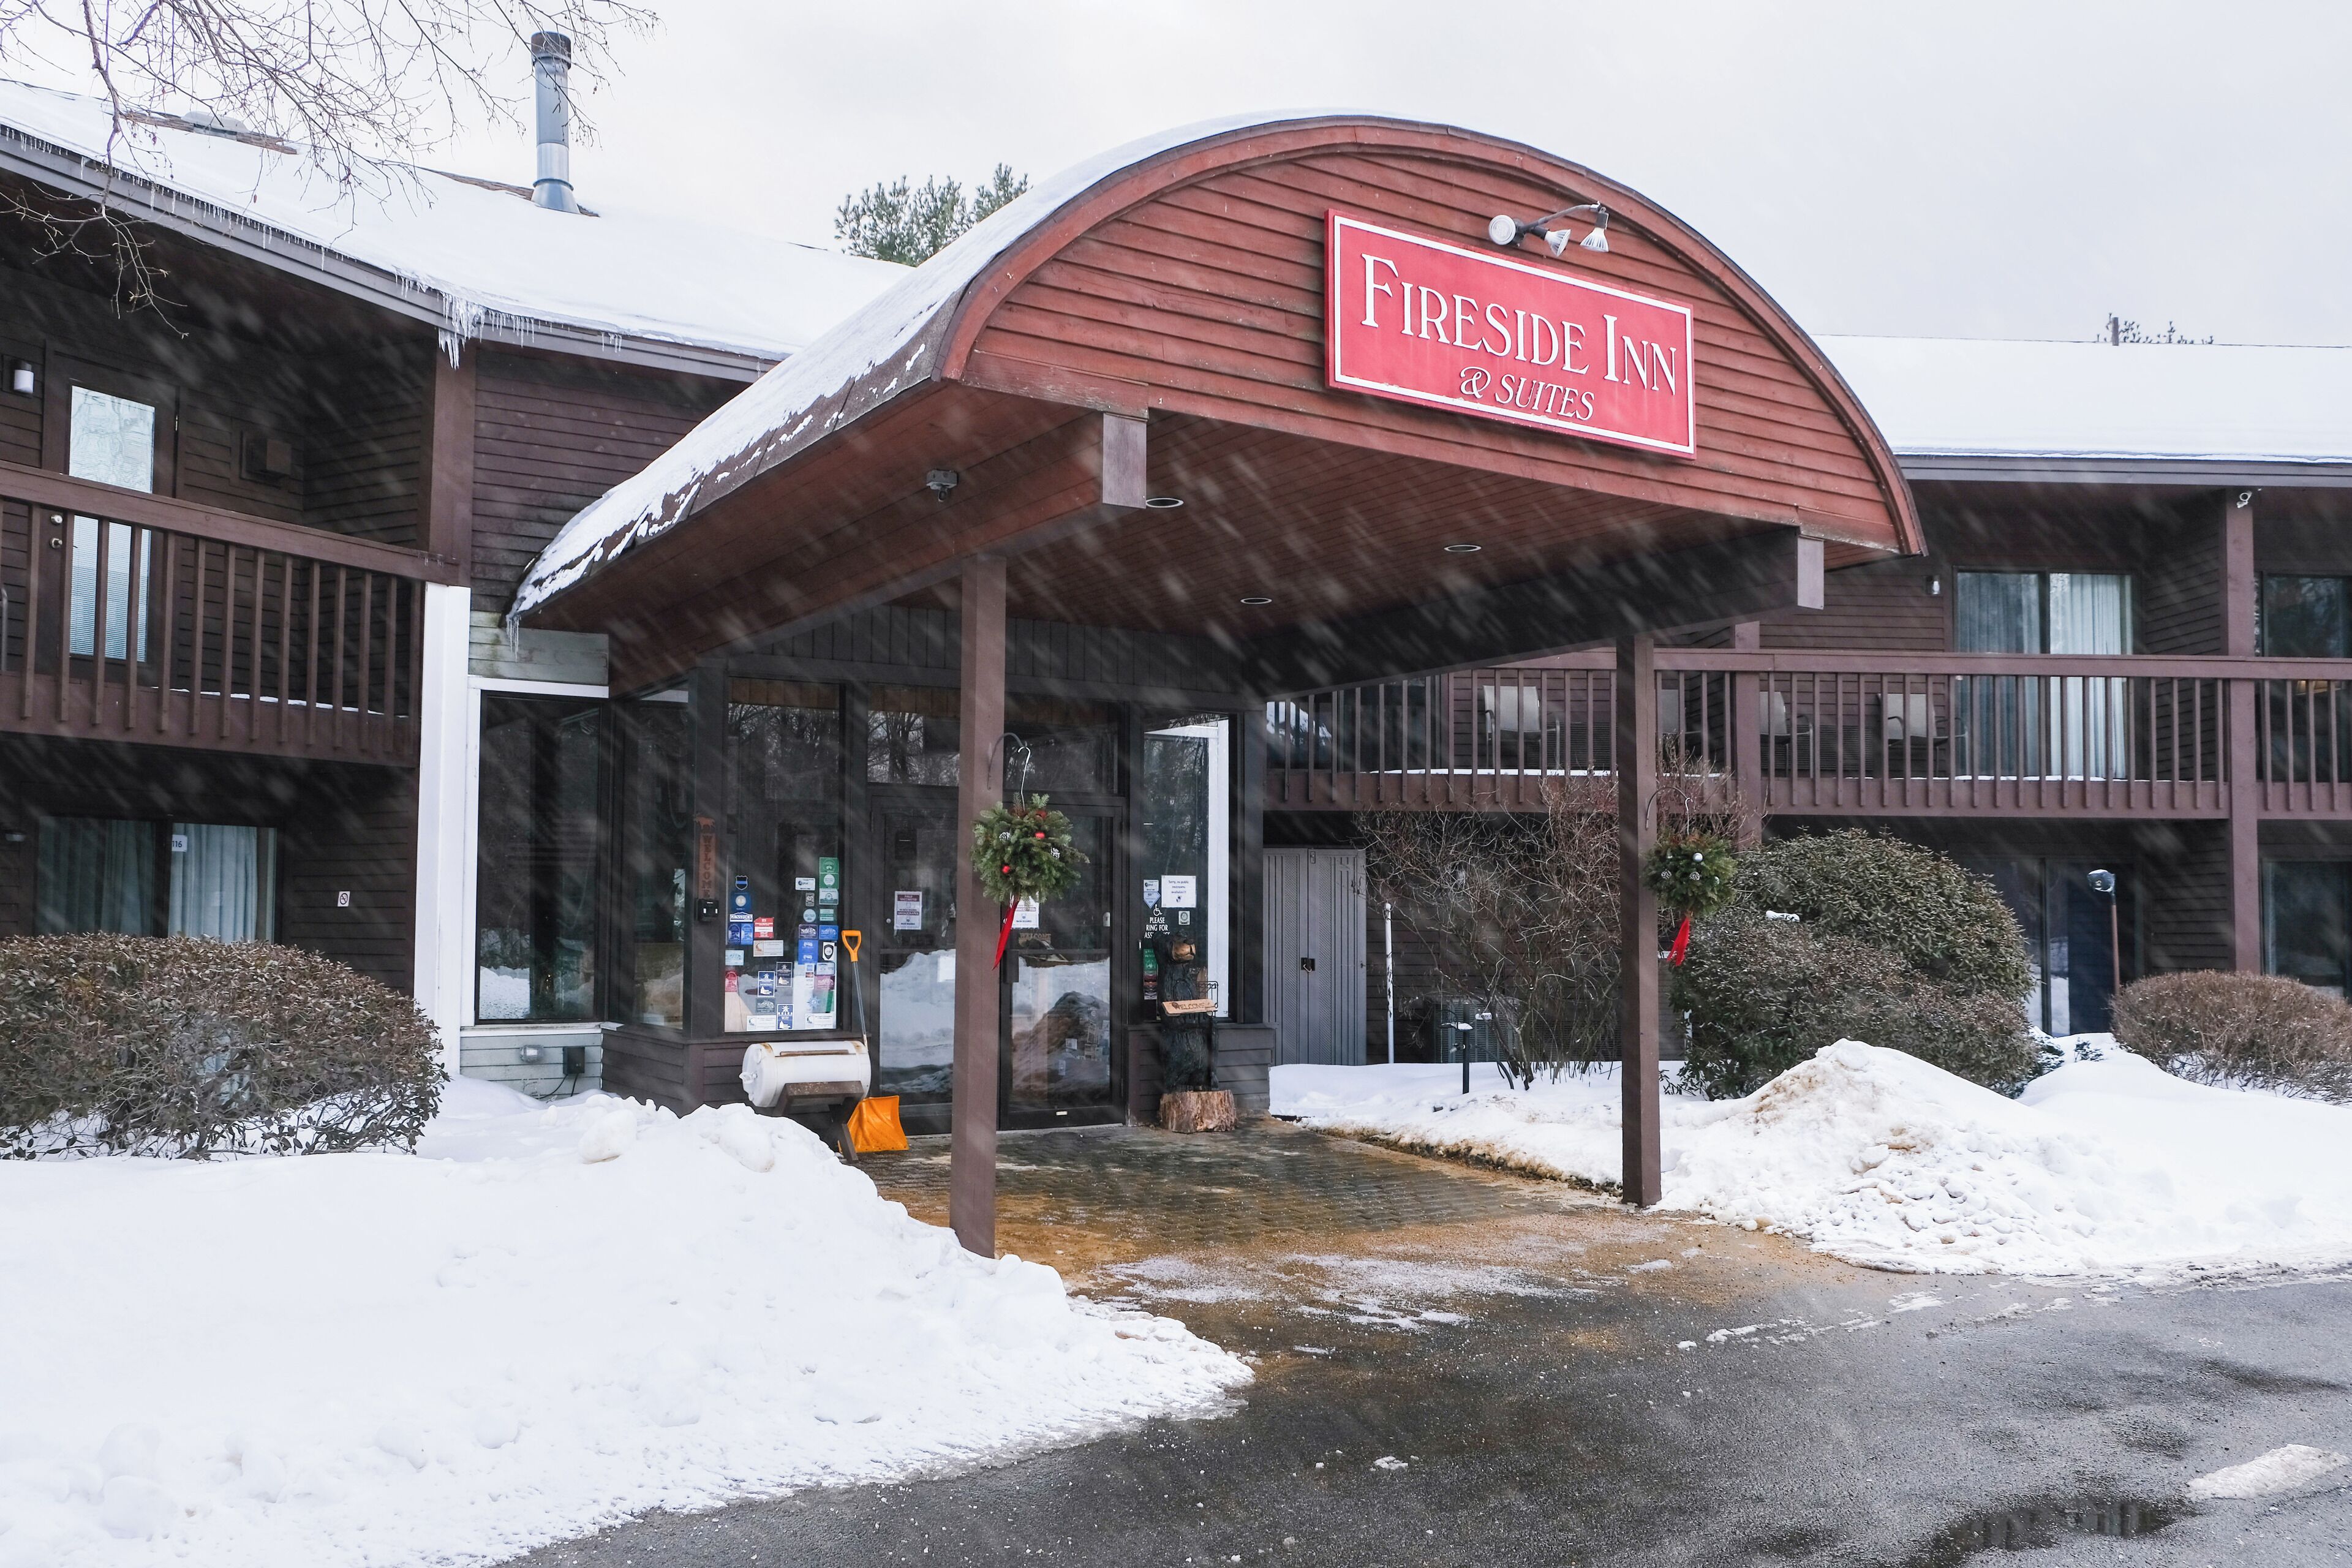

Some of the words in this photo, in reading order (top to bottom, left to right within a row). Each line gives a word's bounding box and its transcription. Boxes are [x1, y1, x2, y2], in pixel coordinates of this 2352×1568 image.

[1361, 253, 1590, 375] FIRESIDE
[1603, 314, 1677, 396] INN
[1460, 366, 1492, 399] &
[1495, 373, 1596, 421] SUITES
[702, 834, 712, 898] WELCOME
